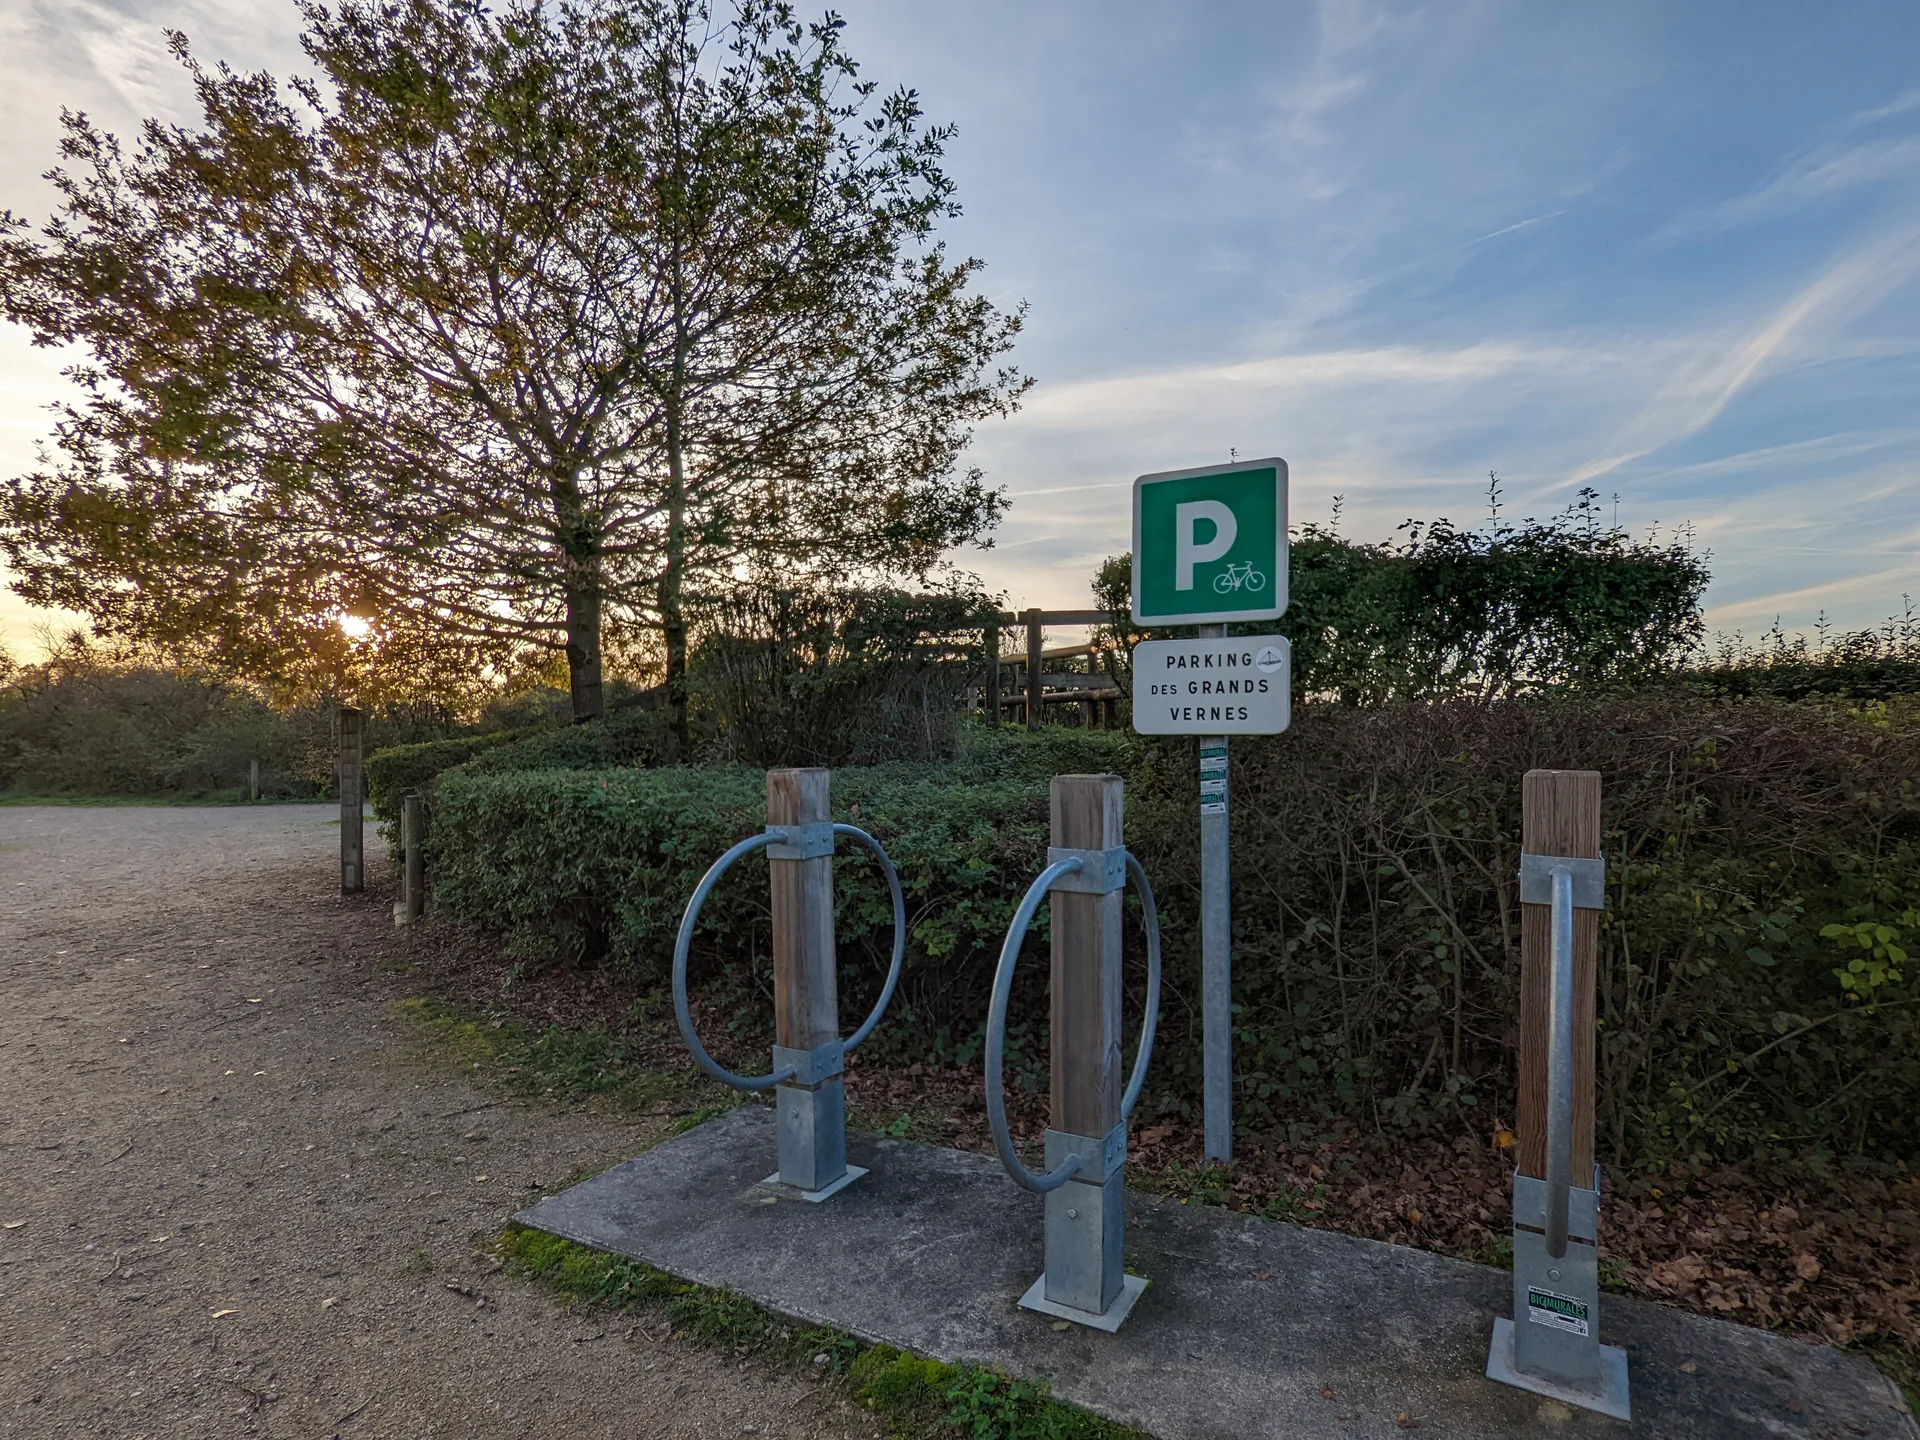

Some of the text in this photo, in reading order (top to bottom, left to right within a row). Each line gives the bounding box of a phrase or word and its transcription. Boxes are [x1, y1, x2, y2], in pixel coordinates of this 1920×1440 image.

[1175, 499, 1238, 592] P
[1166, 653, 1252, 669] PARKING
[1151, 679, 1269, 695] DES GRANDS
[1170, 707, 1248, 721] VERNES
